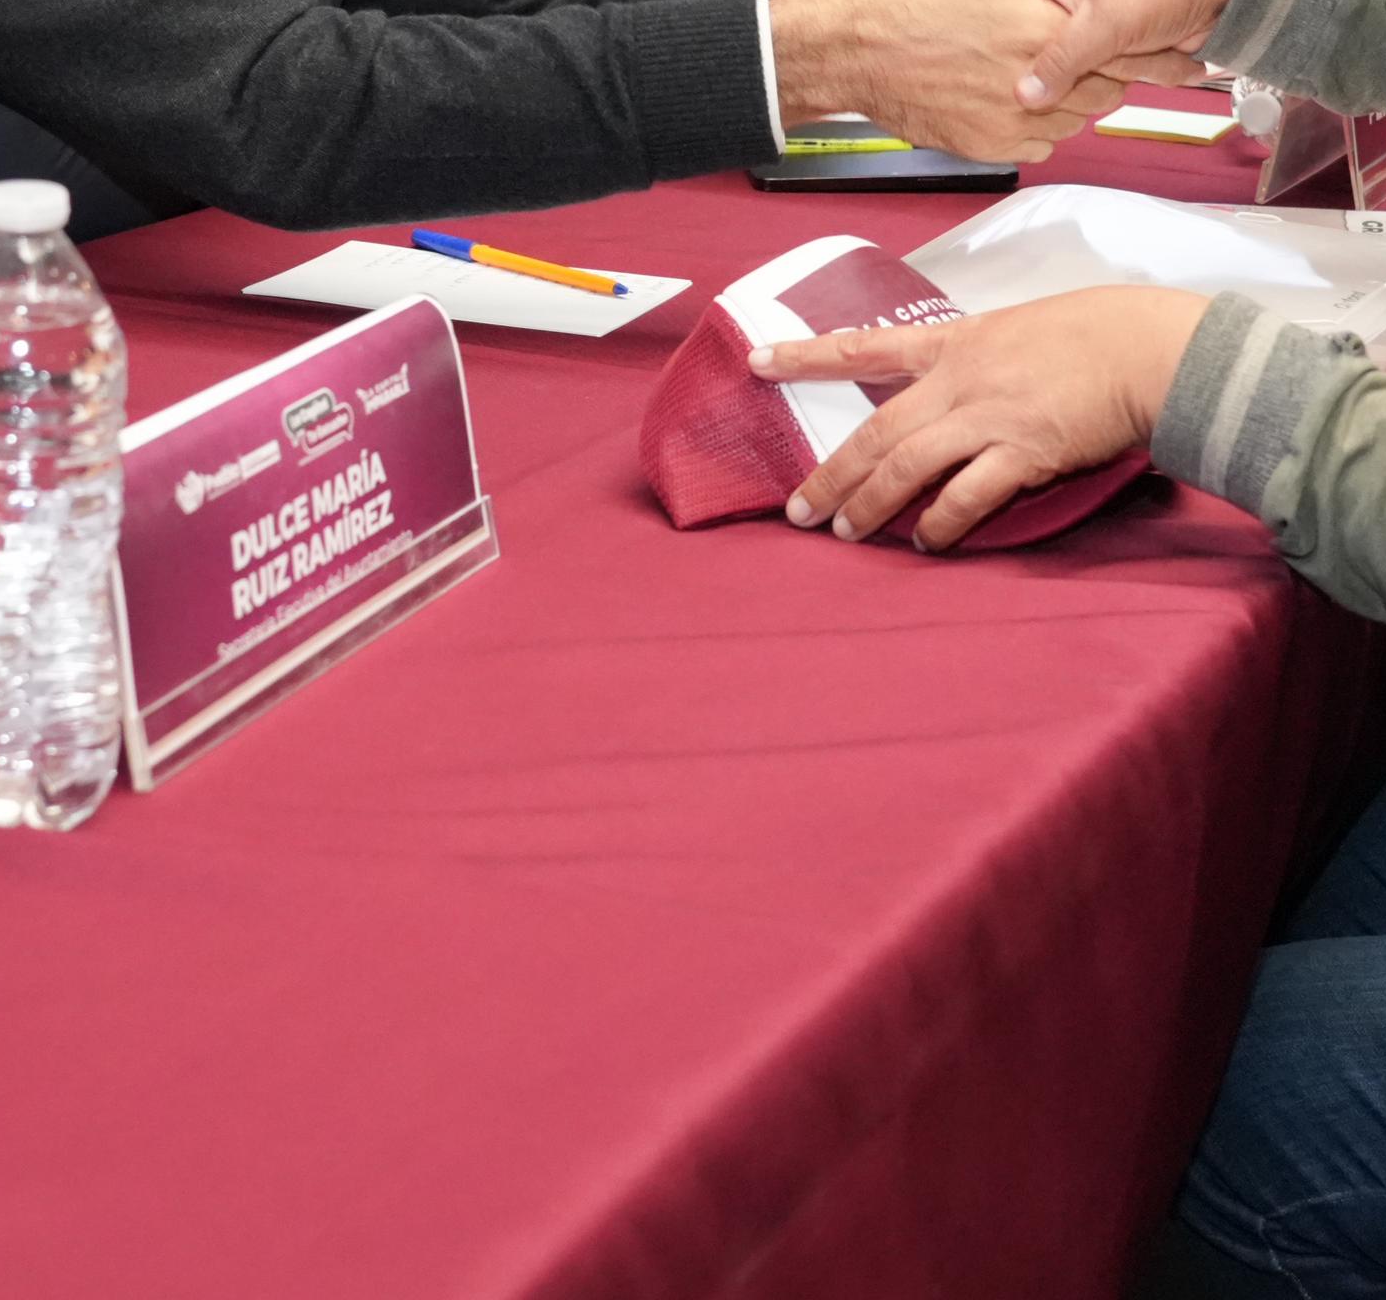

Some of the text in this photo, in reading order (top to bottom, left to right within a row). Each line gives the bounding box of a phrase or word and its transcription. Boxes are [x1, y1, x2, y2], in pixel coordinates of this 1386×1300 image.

[230, 493, 311, 572] DULCE
[311, 448, 387, 523] MARÍA
[231, 489, 395, 620] RUIZ RAMÍREZ
